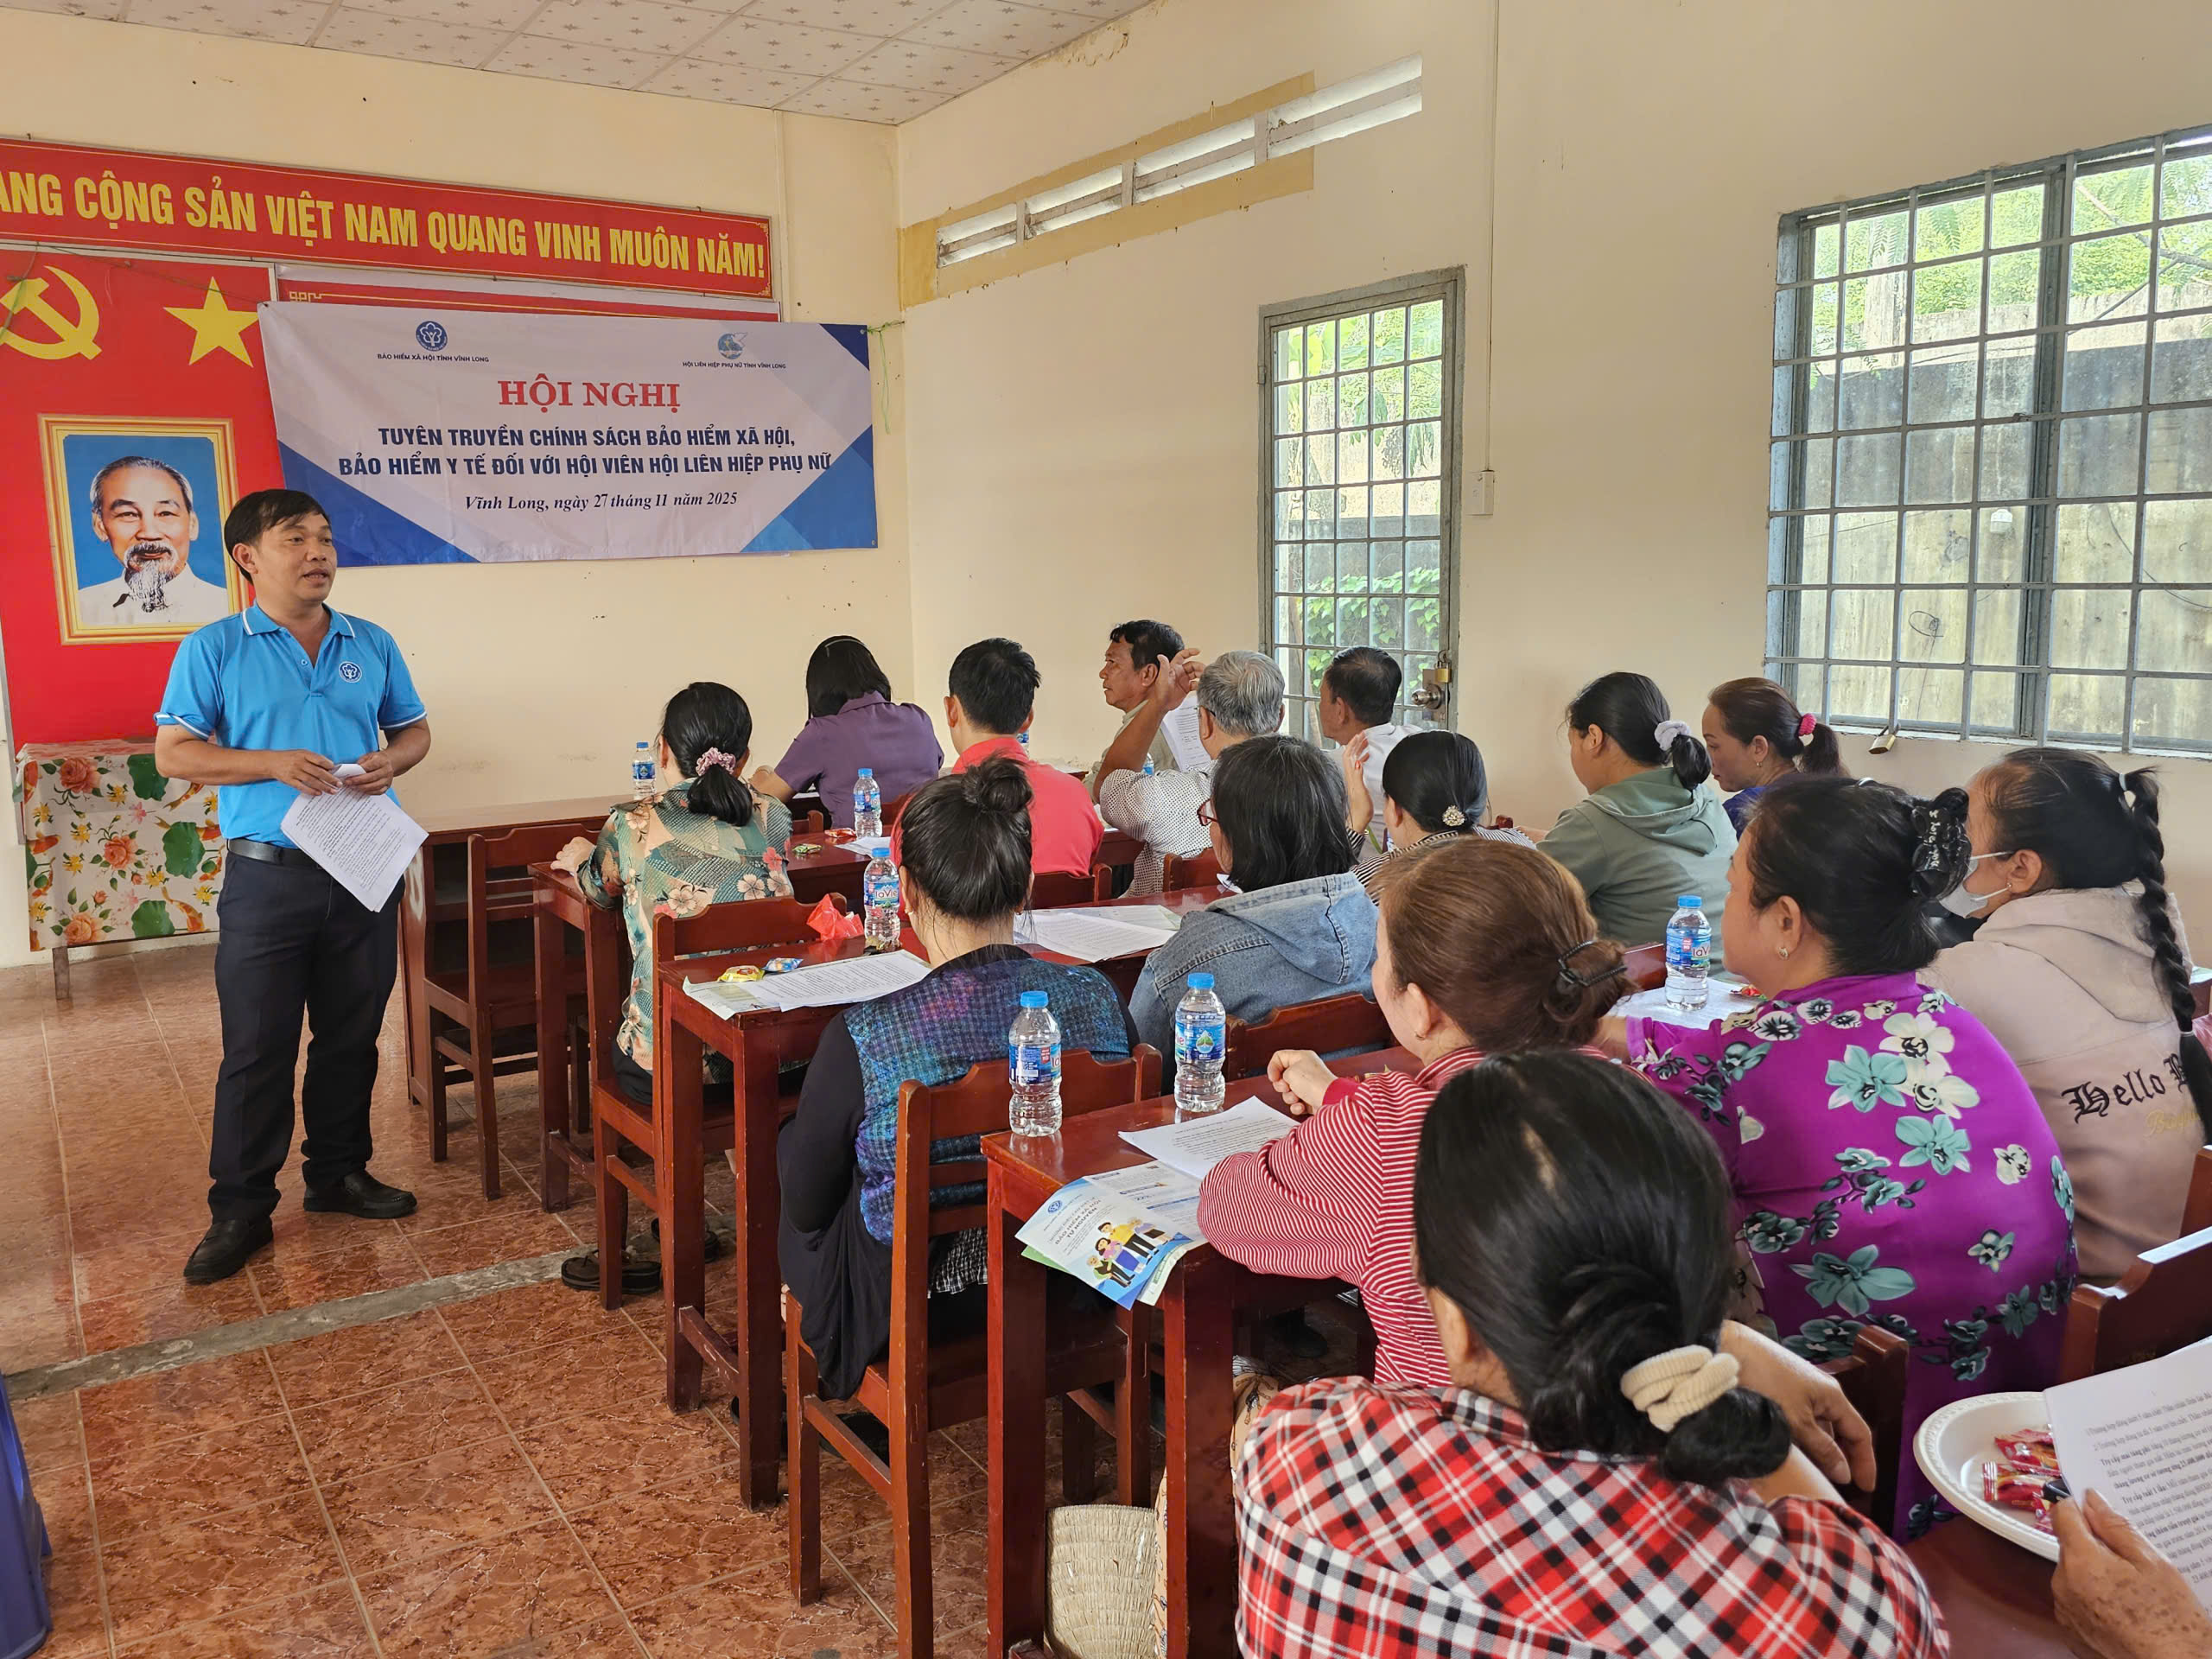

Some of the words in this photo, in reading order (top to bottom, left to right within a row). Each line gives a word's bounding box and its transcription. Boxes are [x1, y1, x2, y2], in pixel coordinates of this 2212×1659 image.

[74, 170, 174, 229] CỘNG
[185, 176, 257, 232] SẢN
[265, 191, 334, 246] VIỆT
[346, 204, 418, 247] NAM
[428, 212, 526, 256] QUANG
[535, 221, 601, 262] VINH
[610, 226, 689, 270] MUÔN
[697, 232, 765, 277] NĂM!
[498, 373, 573, 413] HỘI
[582, 382, 681, 414] NGHỊ
[378, 425, 443, 446] TUYÊN
[448, 423, 524, 447] TRUYỀN
[530, 426, 588, 447] CHÍNH
[593, 426, 641, 447] SÁCH
[646, 424, 682, 446] BẢO
[687, 423, 731, 446] HIỂM
[736, 426, 760, 445] XÃ
[764, 426, 795, 448] HỘI,
[339, 452, 382, 475] BẢO
[388, 451, 442, 475] HIỂM
[446, 458, 458, 475] Y
[463, 453, 486, 475] TẾ
[492, 452, 524, 475] ĐỐI
[530, 454, 561, 475] VỚI
[566, 454, 598, 478] HỘI
[602, 454, 645, 474] VIÊN
[649, 454, 679, 477] HỘI
[683, 454, 723, 474] LIÊN
[728, 454, 764, 475] HIỆP
[768, 454, 803, 474] PHỤ
[807, 452, 832, 471] NỮ
[466, 496, 502, 510] Vĩnh
[507, 496, 550, 512] Long,
[554, 495, 589, 512] ngày
[594, 493, 608, 508] 27
[610, 493, 652, 510] tháng
[655, 493, 668, 506] 11
[673, 493, 703, 505] năm
[706, 492, 738, 505] 2025
[2061, 1069, 2166, 1124] Hello
